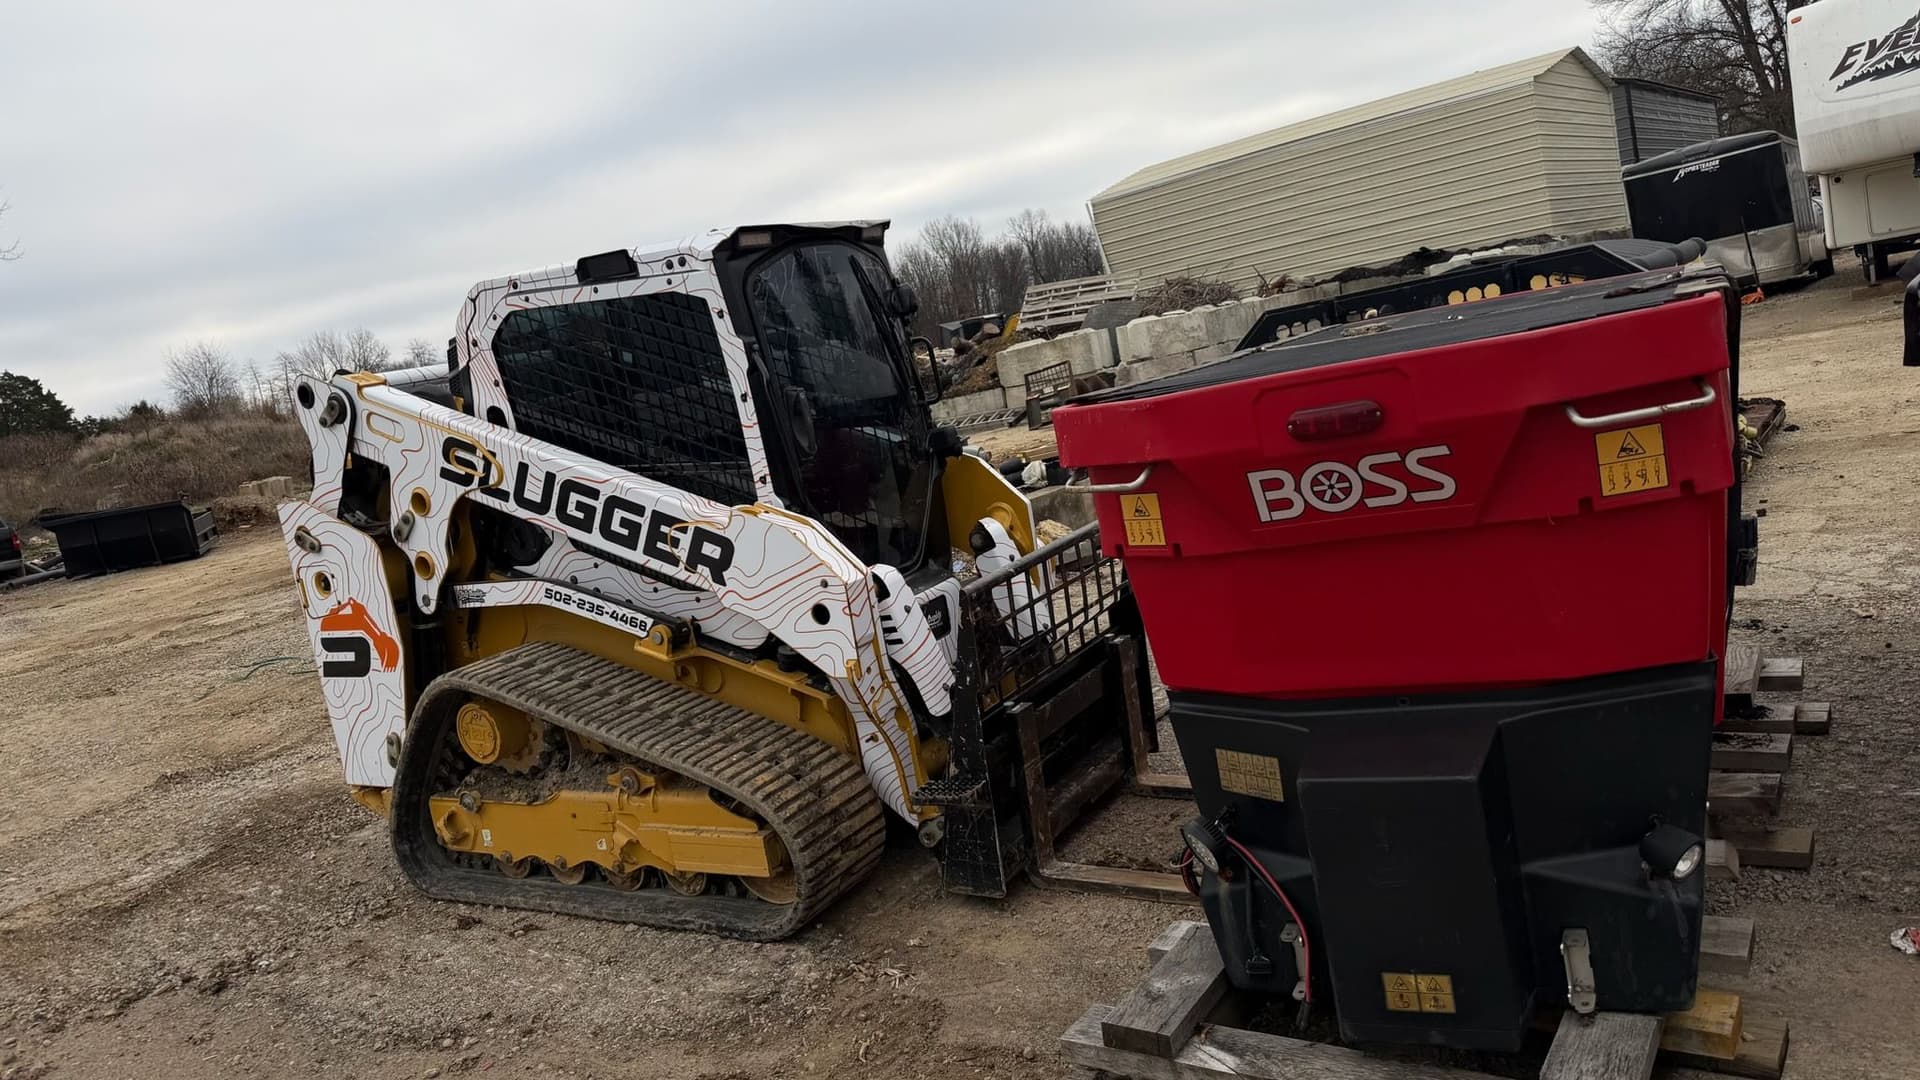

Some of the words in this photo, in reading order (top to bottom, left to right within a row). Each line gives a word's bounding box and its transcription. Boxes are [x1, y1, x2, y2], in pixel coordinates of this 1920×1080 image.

[1828, 27, 1920, 81] EVE
[440, 436, 733, 586] SLUGGER
[1247, 444, 1457, 522] BOSS
[544, 588, 648, 632] 502-235-4468
